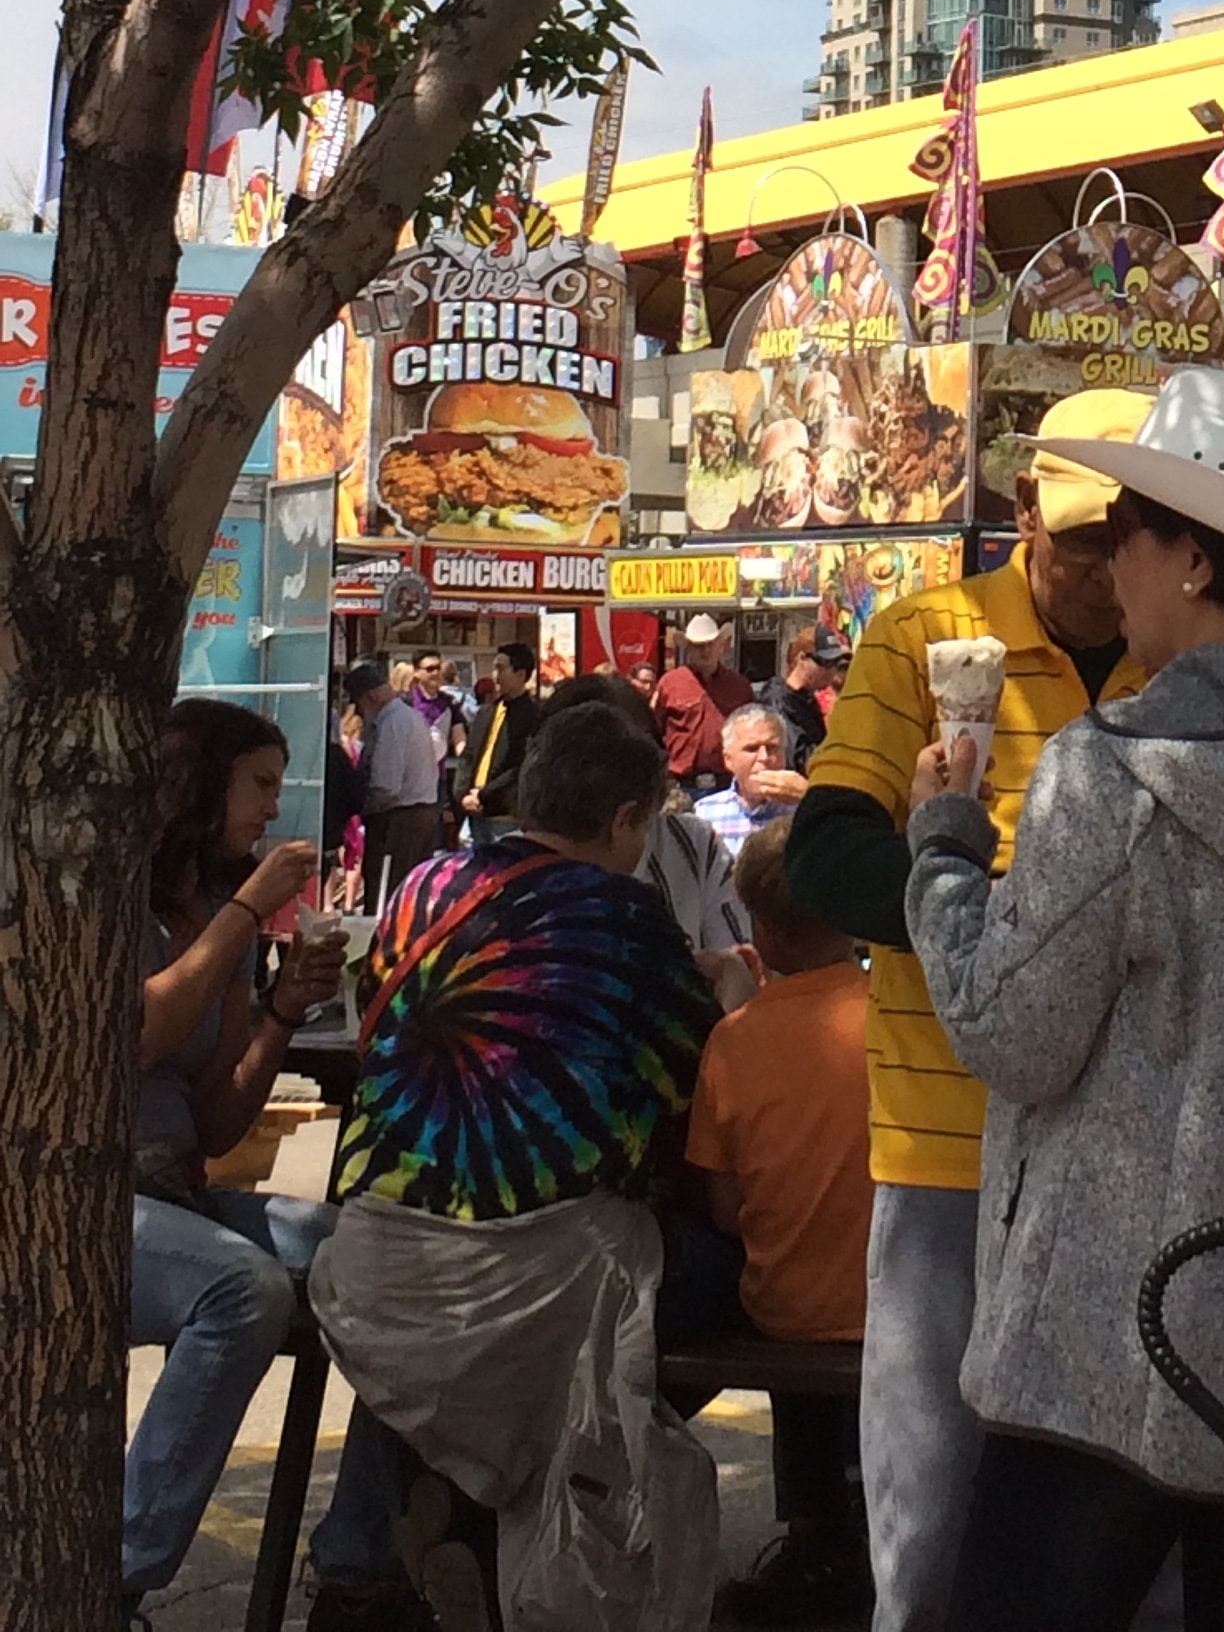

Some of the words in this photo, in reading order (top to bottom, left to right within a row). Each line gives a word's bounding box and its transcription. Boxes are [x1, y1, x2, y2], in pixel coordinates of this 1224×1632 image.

[306, 138, 335, 193] BACON
[323, 88, 345, 138] WRAP
[593, 153, 614, 203] FRIED
[400, 256, 616, 320] Steve-O's
[436, 300, 579, 348] FRIED
[1027, 311, 1121, 346] MARDI
[1131, 320, 1211, 353] GRAS
[392, 342, 615, 400] CHICKEN
[1080, 352, 1157, 385] GRILL
[433, 559, 535, 588] CHICKEN
[620, 563, 652, 595] CAJUN
[655, 562, 694, 594] PULLED
[698, 560, 729, 594] PORK
[193, 612, 235, 630] you
